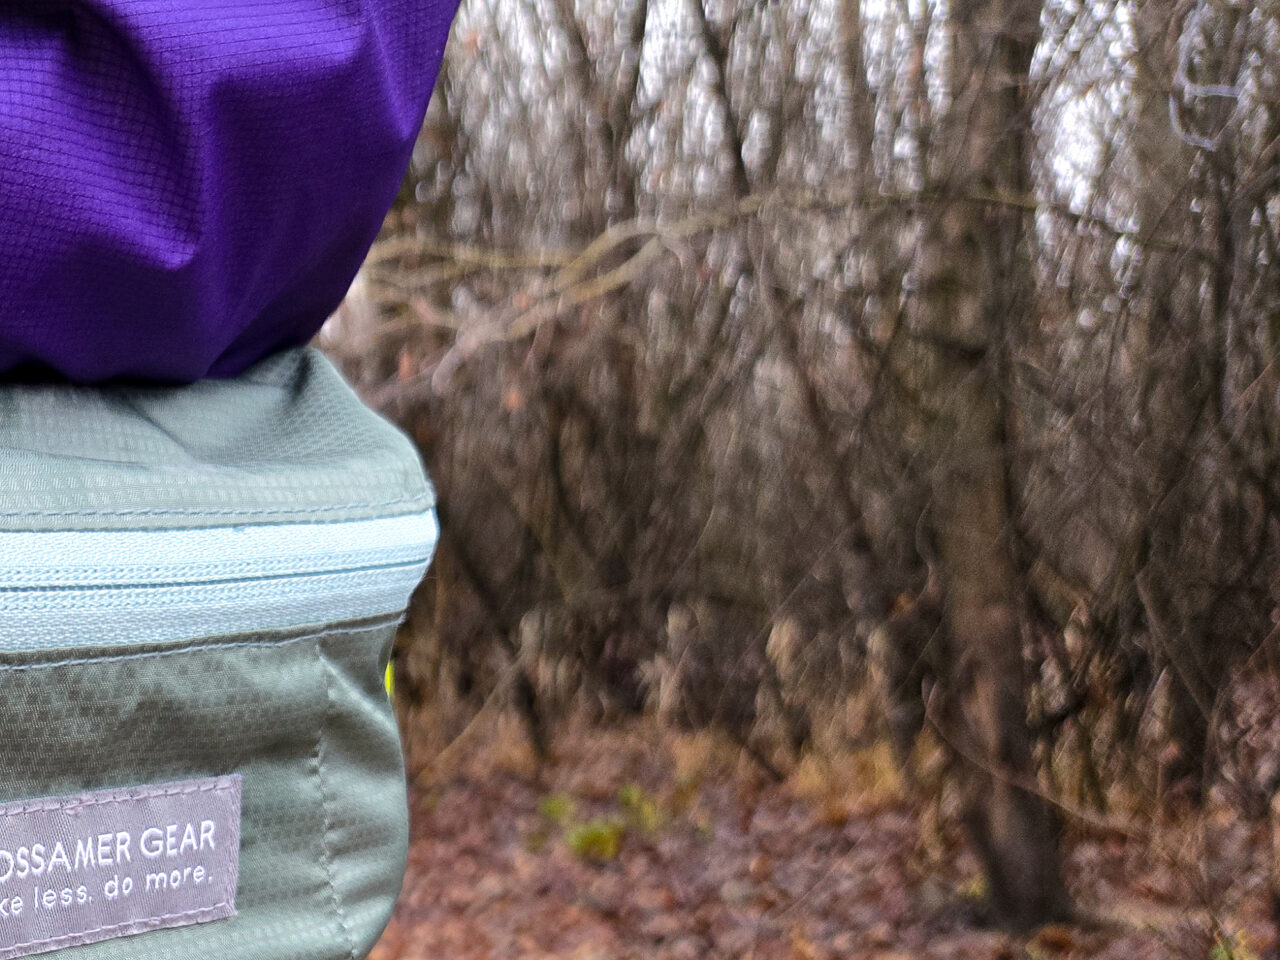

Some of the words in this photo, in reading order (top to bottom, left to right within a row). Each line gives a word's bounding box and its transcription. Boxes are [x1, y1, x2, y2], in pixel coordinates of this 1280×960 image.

[139, 819, 216, 857] GEAR
[104, 873, 133, 900] do
[145, 864, 213, 891] more.
